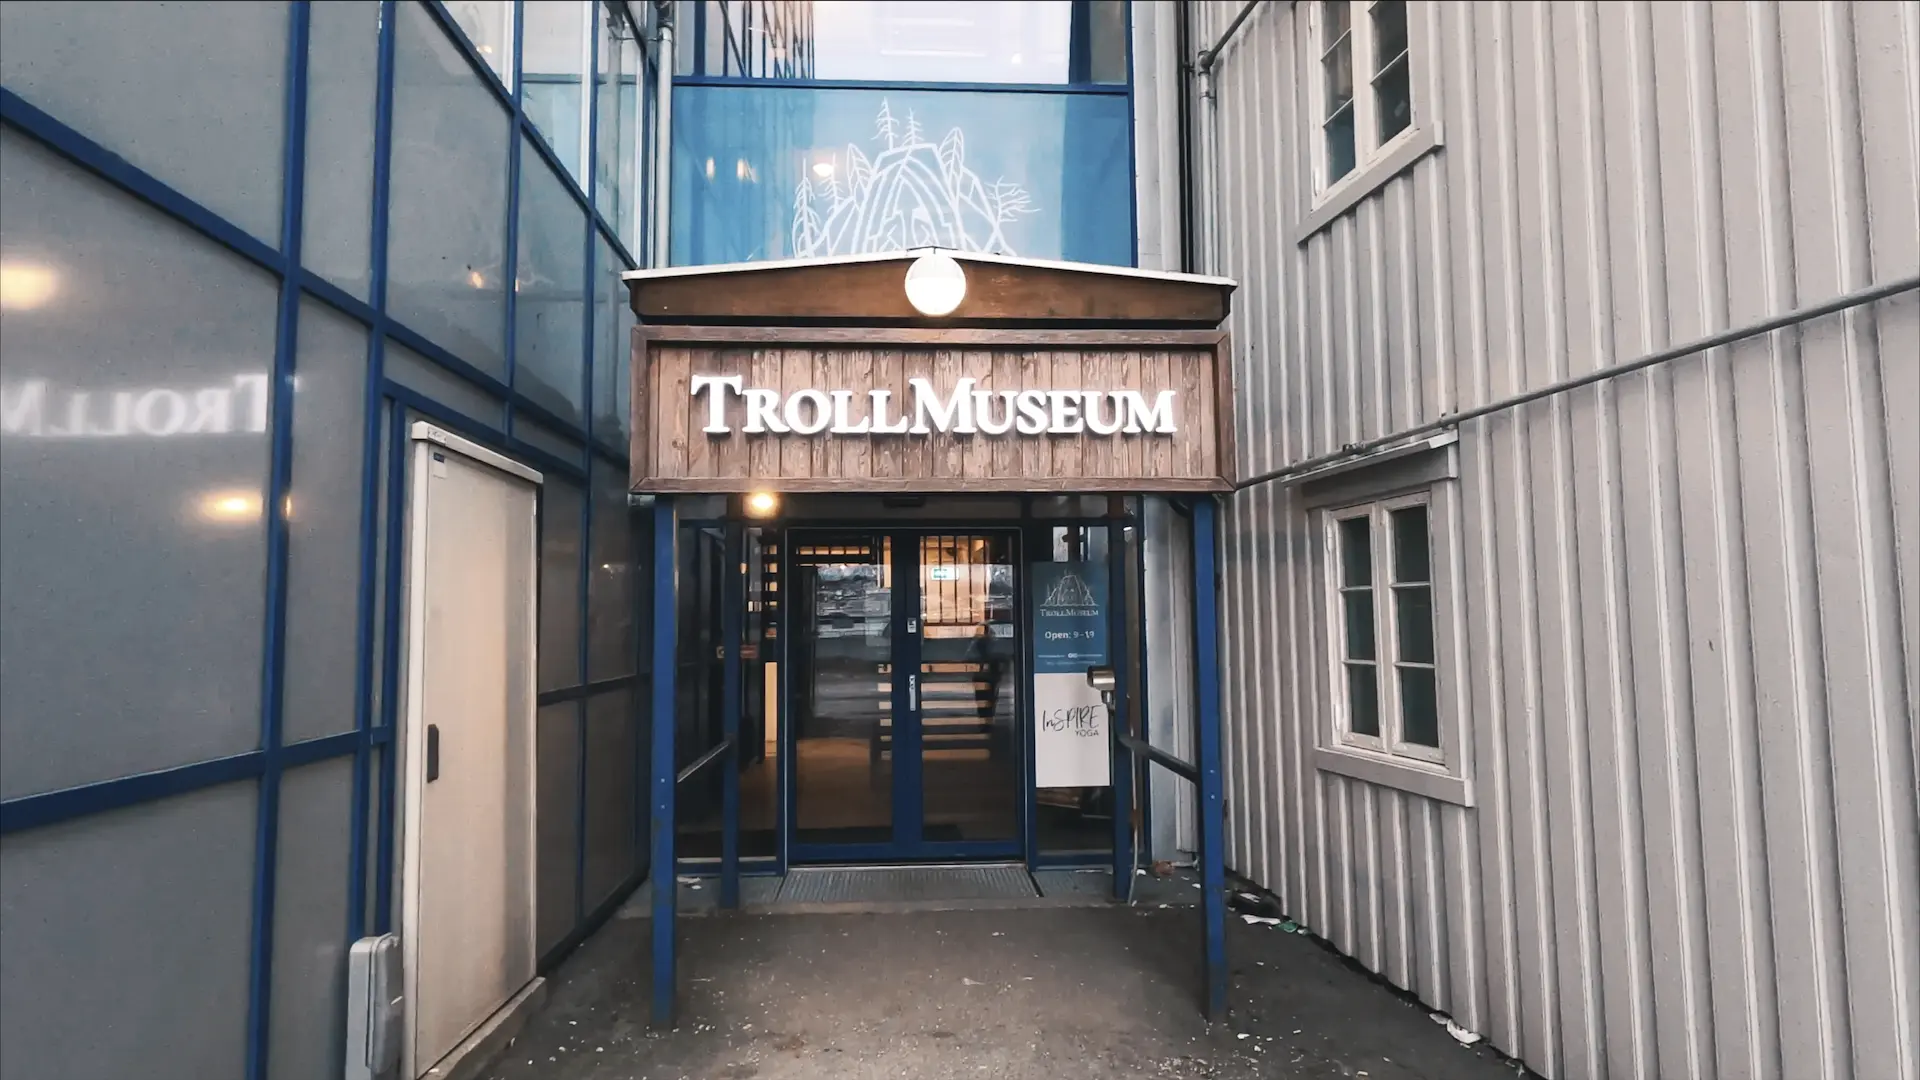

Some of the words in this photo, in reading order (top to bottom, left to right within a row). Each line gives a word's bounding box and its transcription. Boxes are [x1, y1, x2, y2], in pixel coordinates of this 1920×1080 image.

[690, 374, 1178, 436] TROLLMUSEUM
[1044, 630, 1072, 641] Open:
[1075, 729, 1099, 737] YOGA
